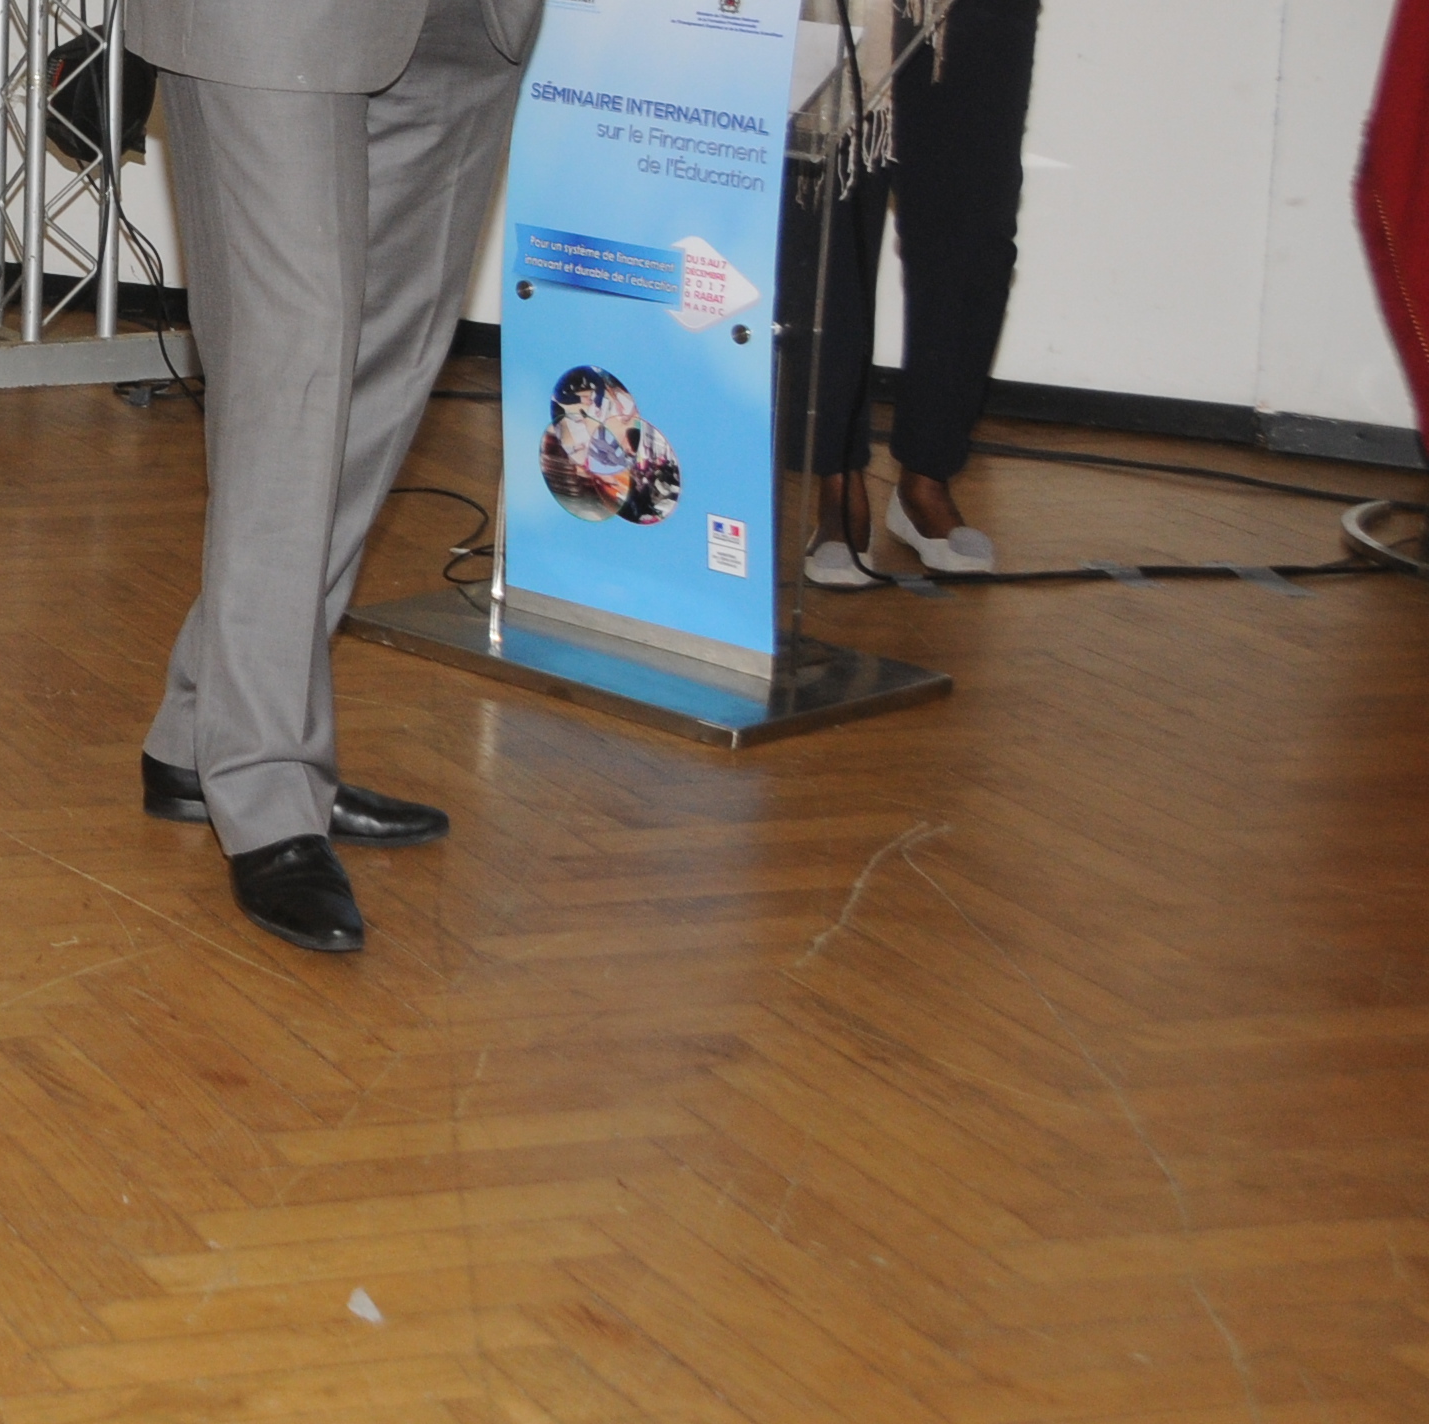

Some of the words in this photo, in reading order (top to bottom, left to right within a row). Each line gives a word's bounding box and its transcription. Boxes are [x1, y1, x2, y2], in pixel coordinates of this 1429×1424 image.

[530, 80, 623, 114] SÉMINAIRE
[626, 97, 770, 136] INTERNATIONAL
[597, 123, 625, 141] sur
[628, 124, 644, 144] le
[648, 126, 768, 164] Financement
[637, 155, 661, 175] de
[666, 155, 765, 192] l'Éducation
[524, 253, 562, 271] innovant
[564, 263, 573, 273] et
[574, 264, 611, 281] durable
[611, 272, 625, 283] de
[530, 235, 550, 249] Pour
[551, 242, 562, 252] un
[564, 244, 601, 260] système
[602, 250, 616, 263] de
[616, 251, 675, 273] financement
[686, 254, 699, 265] DU
[700, 257, 706, 266] 5
[707, 259, 720, 269] AU
[721, 261, 727, 269] 7
[694, 290, 725, 304] RABAT
